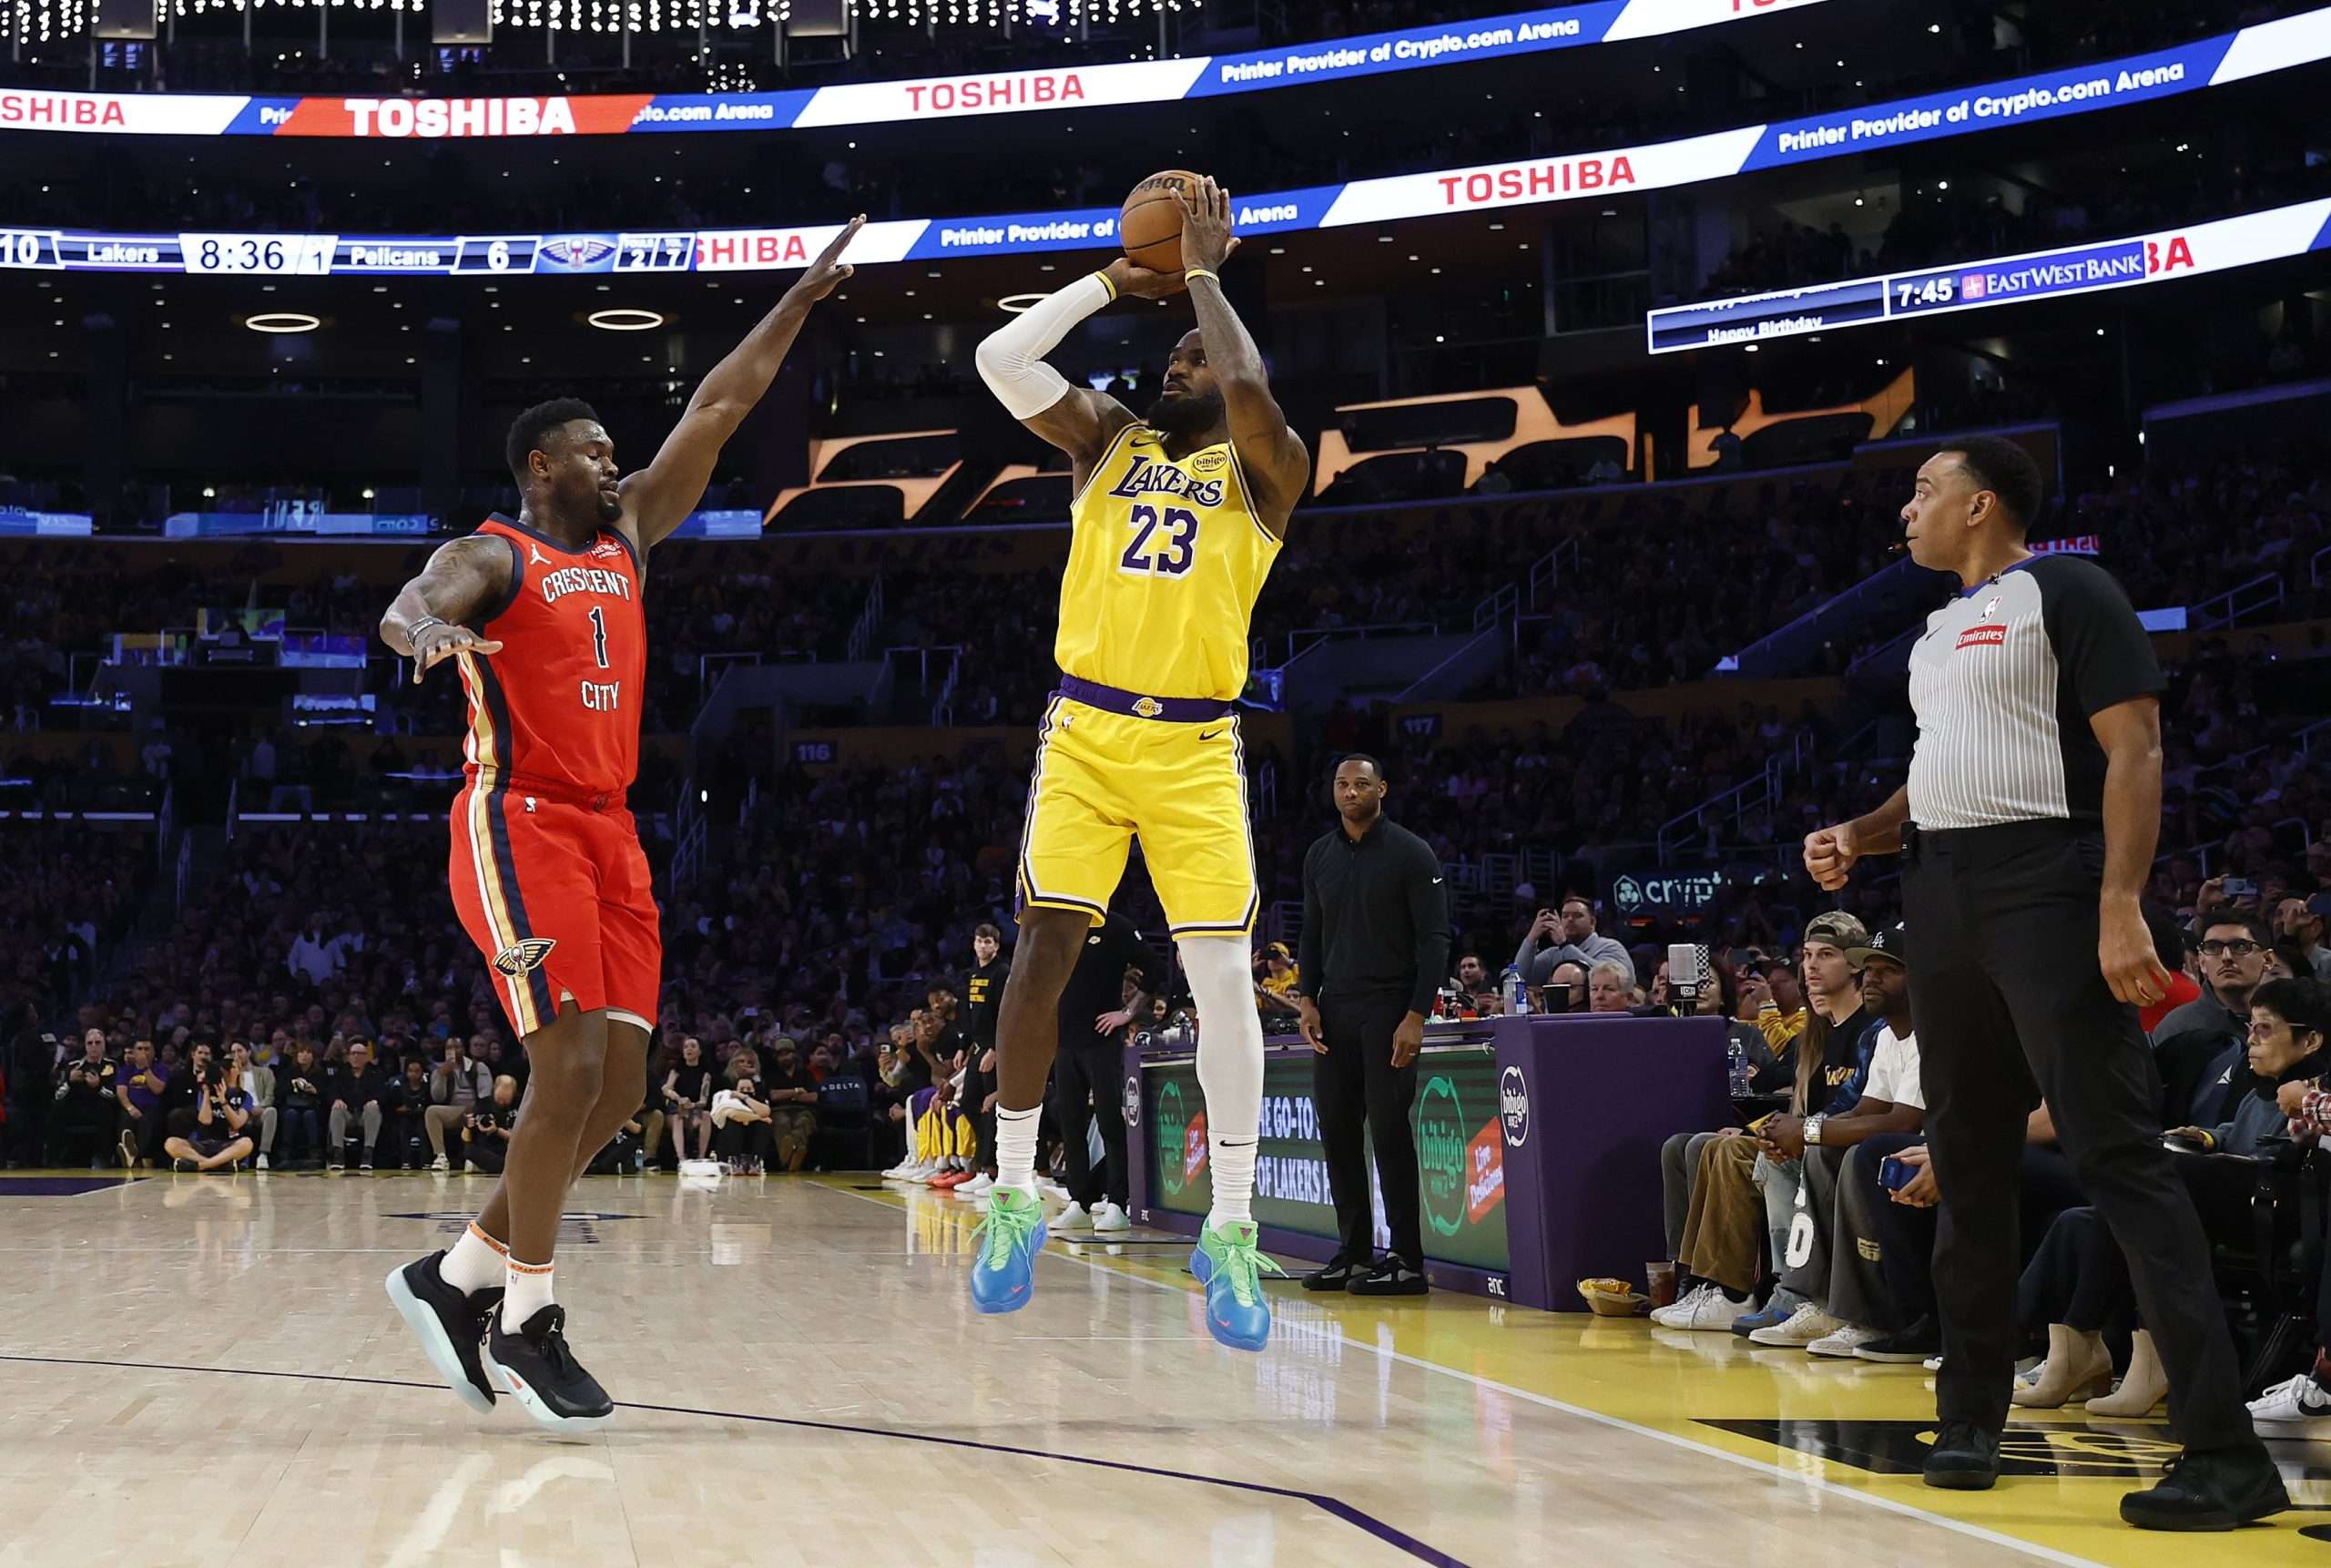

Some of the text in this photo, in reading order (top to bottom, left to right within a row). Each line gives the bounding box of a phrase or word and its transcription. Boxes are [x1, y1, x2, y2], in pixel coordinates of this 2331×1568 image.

[1221, 18, 1580, 83] Printer Provider of Crypto.com Arena
[905, 74, 1084, 111] TOSHIBA
[1778, 62, 2184, 153] Printer Provider of Crypto.com Arena
[344, 97, 576, 137] TOSHIBA
[714, 102, 773, 120] Arena
[1438, 156, 1635, 205] TOSHIBA
[1239, 203, 1298, 226] Arena
[941, 218, 1114, 248] Printer Provider of
[1, 234, 39, 265] 10
[87, 242, 159, 262] Lakers
[200, 239, 284, 270] 8:36
[312, 250, 322, 270] 1
[351, 246, 441, 265] Pelicans
[487, 240, 510, 270] 6
[630, 249, 647, 268] 2
[666, 249, 682, 268] 7
[1898, 277, 1953, 308] 7:45
[1196, 455, 1226, 466] bibigo
[1107, 454, 1226, 508] LAKERS
[1118, 504, 1199, 579] 23
[541, 566, 630, 603] CRESCENT
[587, 606, 610, 669] 1
[1958, 629, 2003, 646] Emirates
[581, 680, 620, 711] CITY
[798, 743, 831, 762] 116
[828, 1082, 860, 1091] DELTA
[1273, 1095, 1314, 1141] GO-TO
[1502, 1088, 1526, 1123] bibigo
[1421, 1120, 1464, 1190] bibigo
[1474, 1144, 1491, 1172] Live
[1256, 1156, 1271, 1197] OF
[1274, 1156, 1321, 1205] LAKERS
